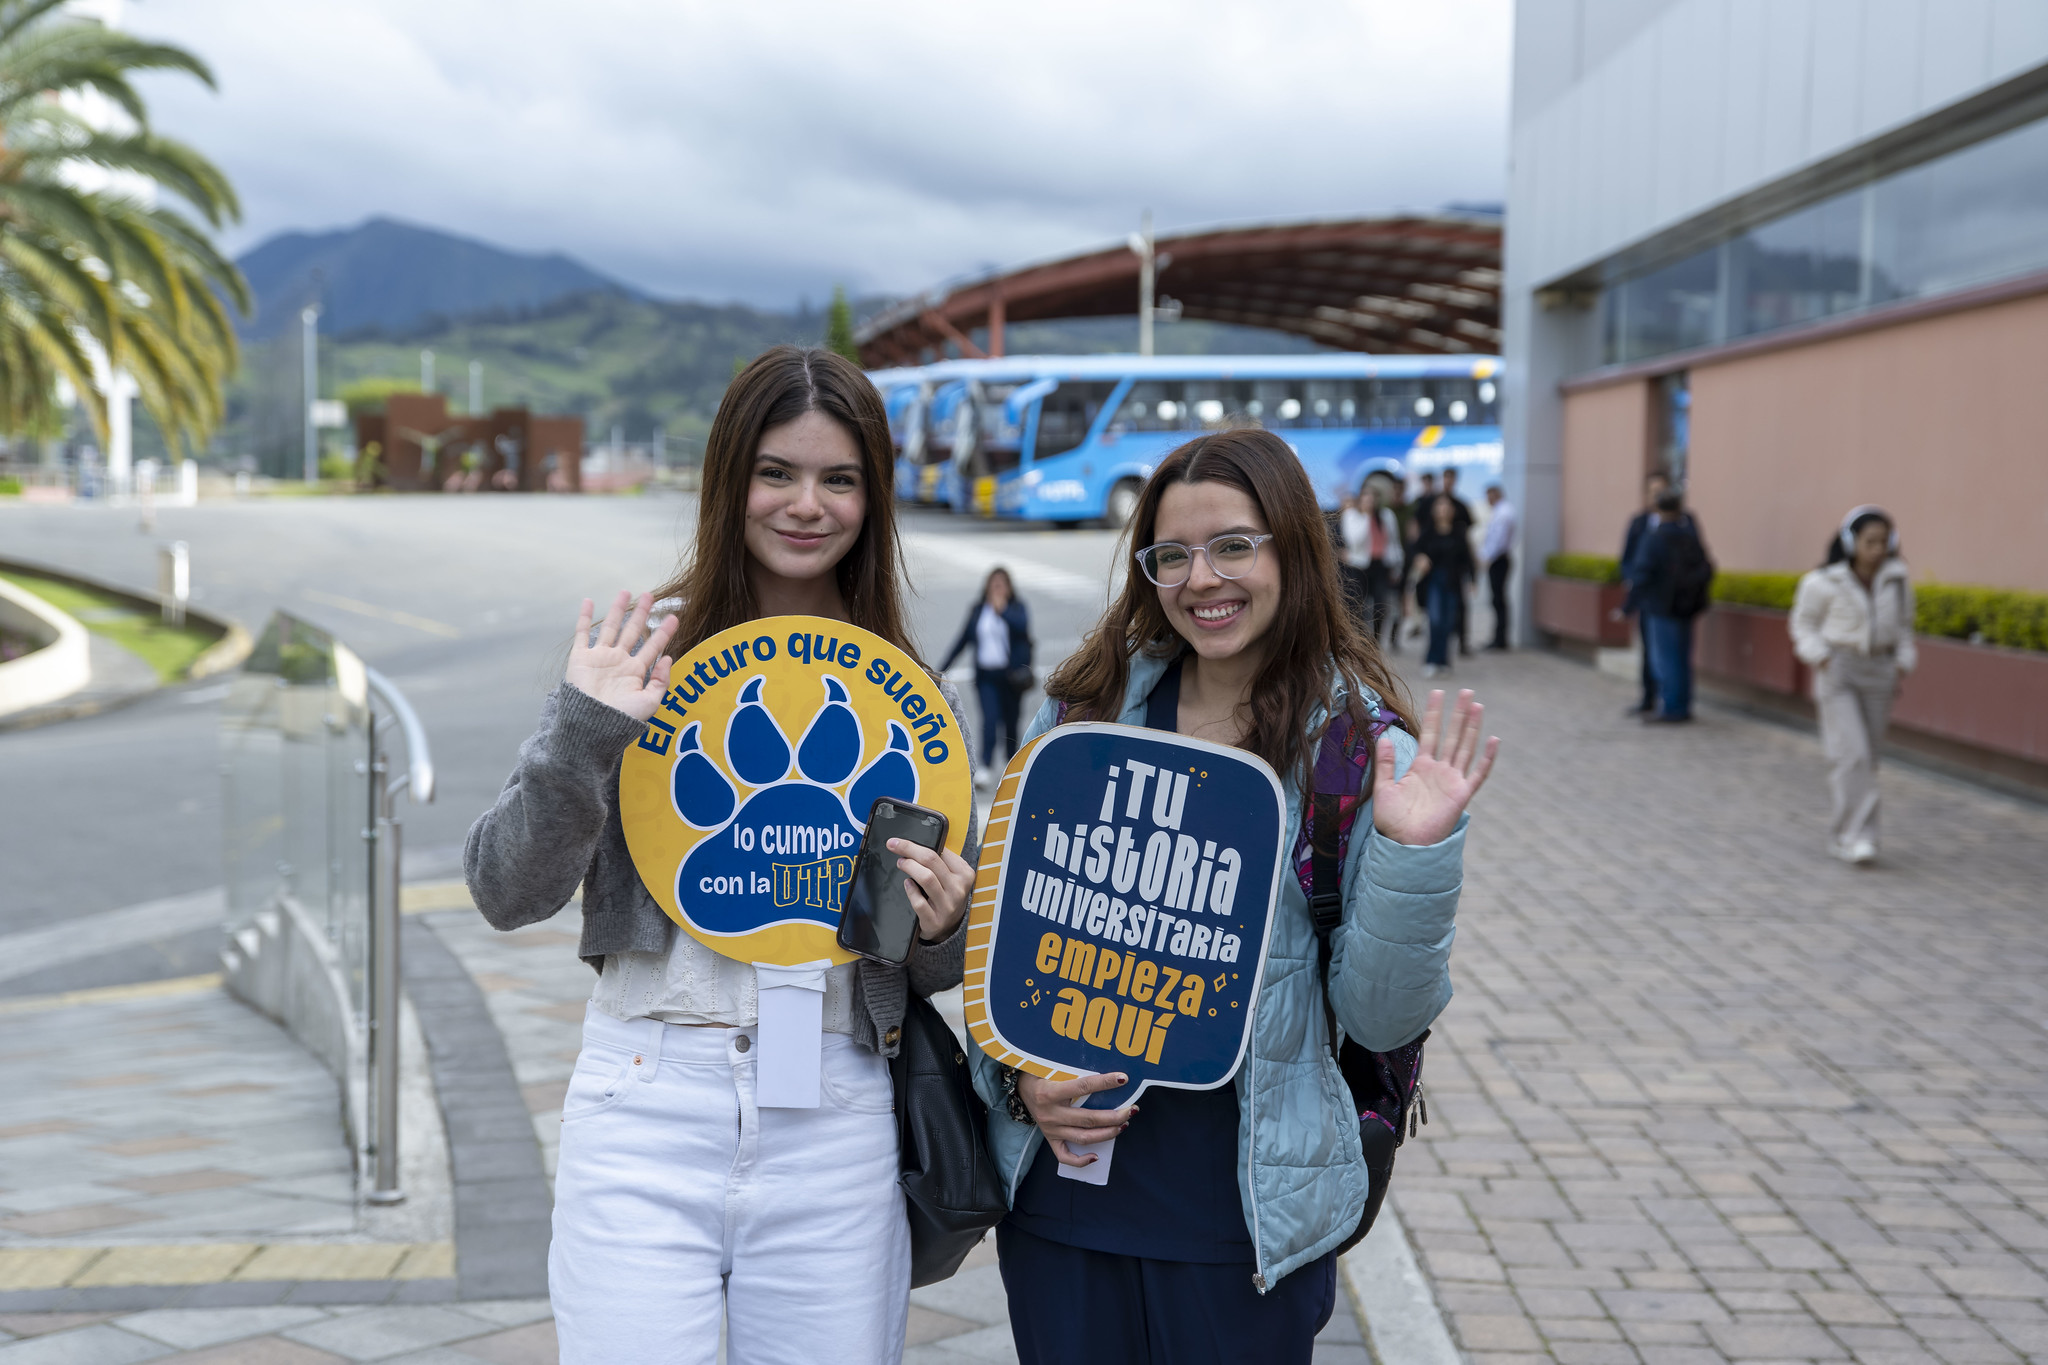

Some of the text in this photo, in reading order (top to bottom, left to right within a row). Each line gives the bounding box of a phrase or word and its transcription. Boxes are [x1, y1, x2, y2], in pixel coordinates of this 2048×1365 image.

[638, 632, 949, 765] El futuro que sueño
[734, 823, 855, 859] lo cumplo
[699, 855, 858, 912] con la UTP
